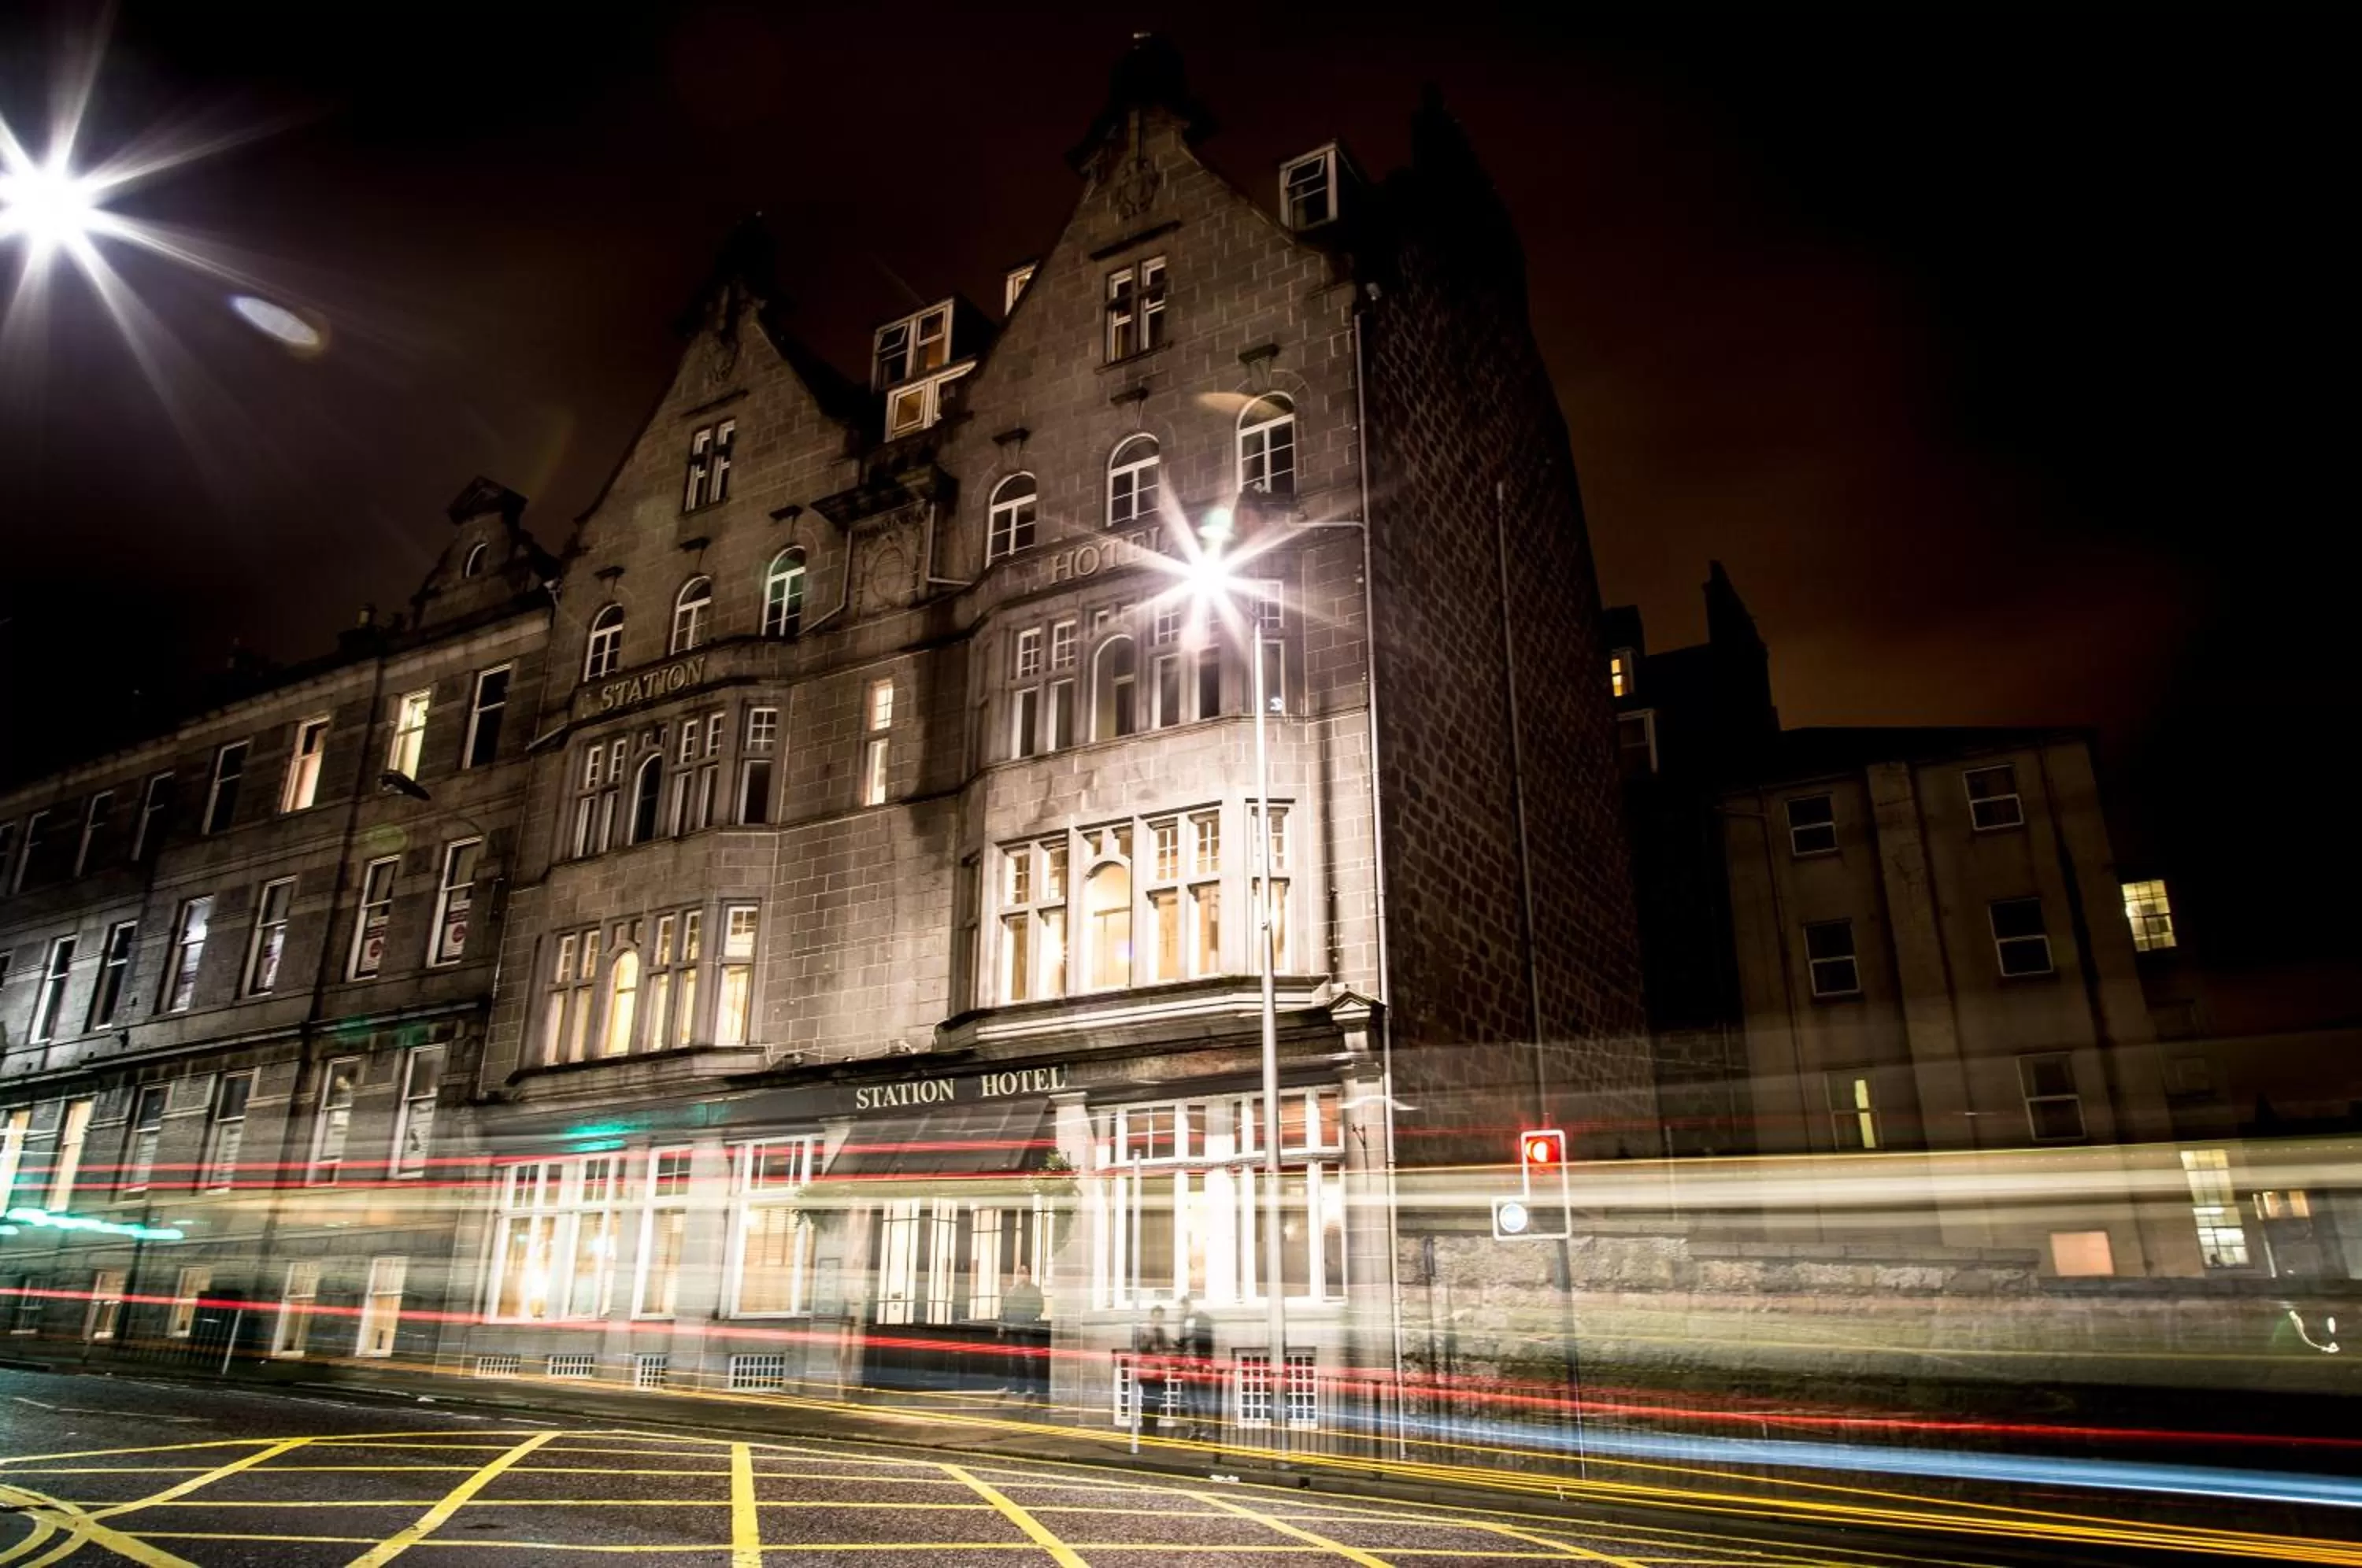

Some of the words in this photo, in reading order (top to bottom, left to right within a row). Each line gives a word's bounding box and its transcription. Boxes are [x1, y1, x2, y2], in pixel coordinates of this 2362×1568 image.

[601, 654, 706, 711] STATION
[856, 1078, 954, 1109] STATION
[981, 1067, 1066, 1096] HOTEL
